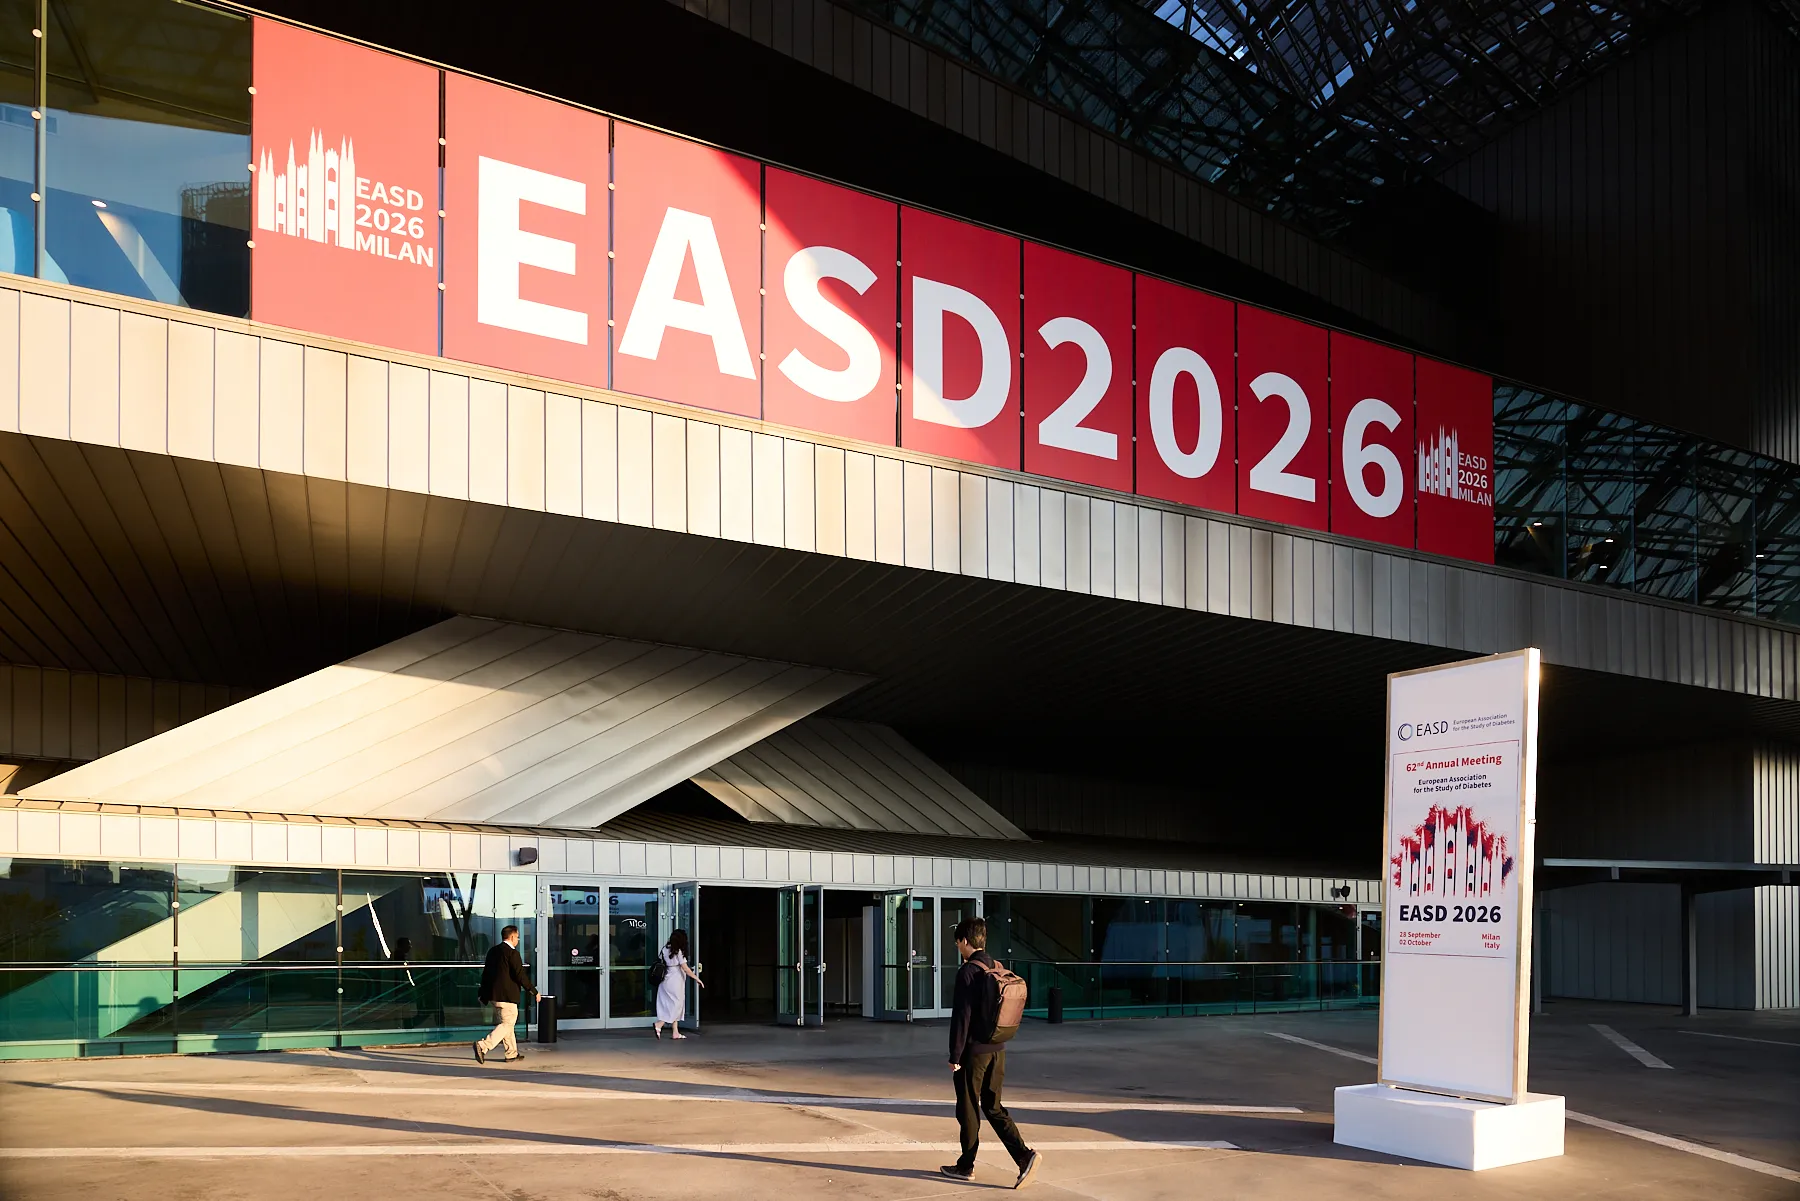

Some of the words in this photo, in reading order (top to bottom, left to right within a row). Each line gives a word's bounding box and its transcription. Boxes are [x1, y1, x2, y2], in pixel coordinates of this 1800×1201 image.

[355, 176, 424, 211] EASD
[355, 203, 424, 239] 2026
[355, 230, 434, 268] MILAN
[1458, 452, 1487, 470] EASD
[1458, 469, 1488, 489] 2026
[1458, 486, 1492, 507] MILAN
[1453, 718, 1477, 726] European
[1478, 713, 1508, 723] Association
[1461, 724, 1470, 732] the
[1470, 722, 1485, 730] Study
[1492, 719, 1515, 727] Diabetes
[1416, 720, 1449, 737] EASD
[1425, 758, 1459, 770] Annual
[1461, 754, 1502, 765] Meeting
[1418, 776, 1448, 786] European
[1449, 773, 1487, 783] Association
[1424, 784, 1434, 793] the
[1435, 783, 1453, 792] Study
[1454, 782, 1462, 790] of
[1463, 780, 1492, 789] Diabetes
[1399, 905, 1447, 922] EASD
[1452, 905, 1502, 923] 2026
[1484, 942, 1500, 950] Italy
